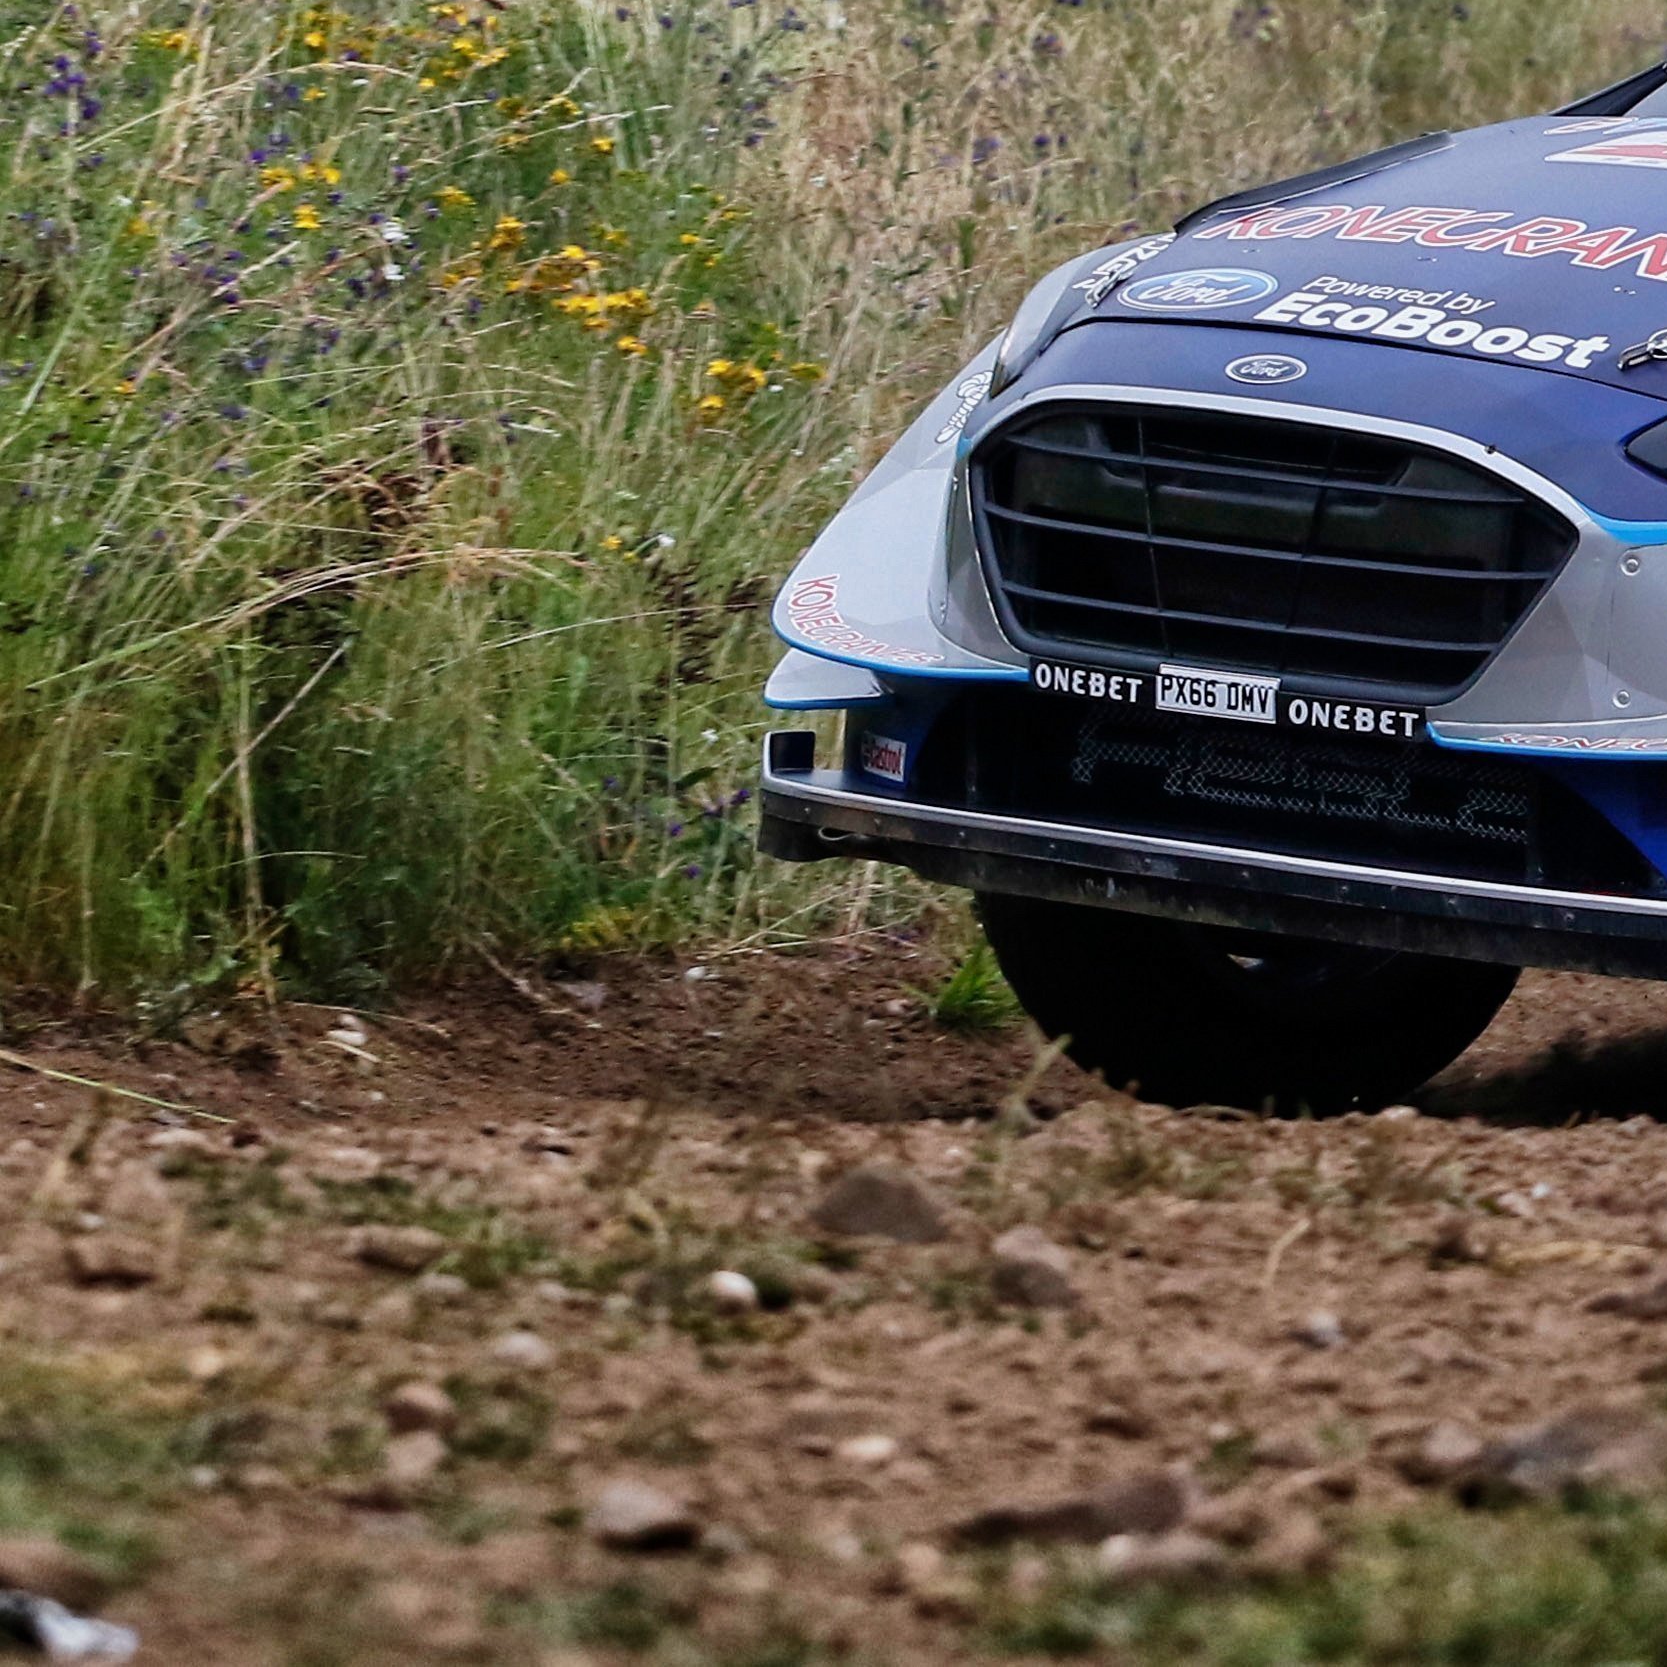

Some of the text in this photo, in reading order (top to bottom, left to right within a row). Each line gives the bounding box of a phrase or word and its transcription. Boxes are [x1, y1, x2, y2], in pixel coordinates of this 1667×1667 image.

[1301, 275, 1498, 316] Powered by
[1253, 290, 1611, 370] EcoBoost
[787, 574, 945, 664] KONECRANES
[1034, 662, 1143, 704] ONEBET
[1160, 677, 1271, 717] PX66 DMV
[1288, 699, 1420, 738] ONEBET
